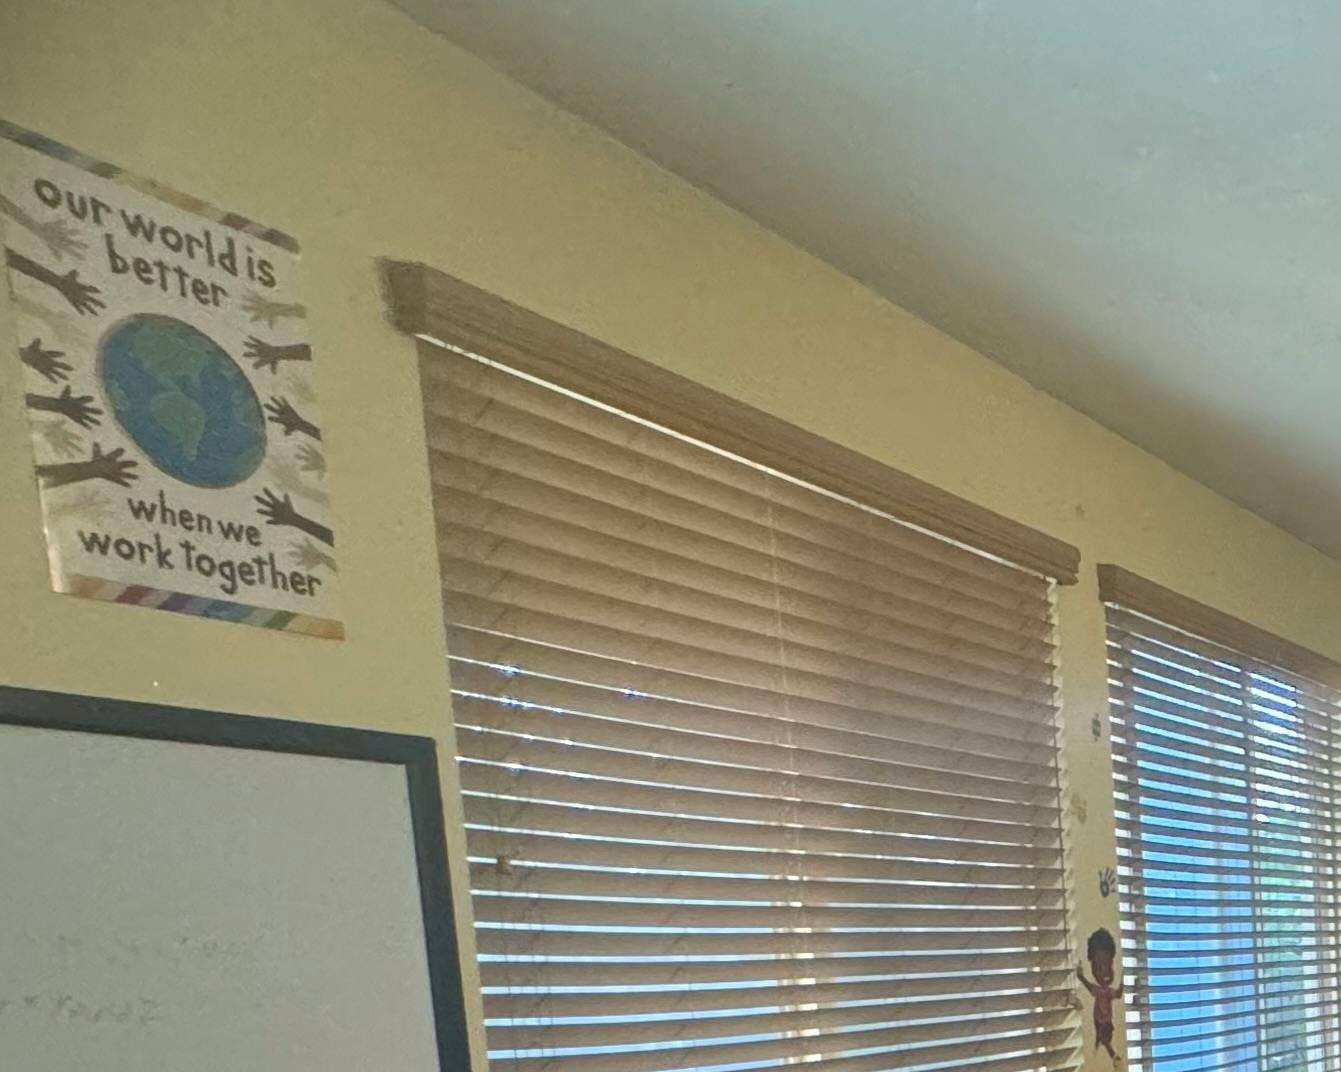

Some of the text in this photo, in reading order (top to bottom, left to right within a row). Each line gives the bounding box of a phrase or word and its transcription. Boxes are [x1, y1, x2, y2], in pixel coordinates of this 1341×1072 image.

[34, 178, 277, 288] our world is
[106, 234, 229, 308] better
[128, 491, 262, 547] when we
[77, 529, 323, 599] work together
